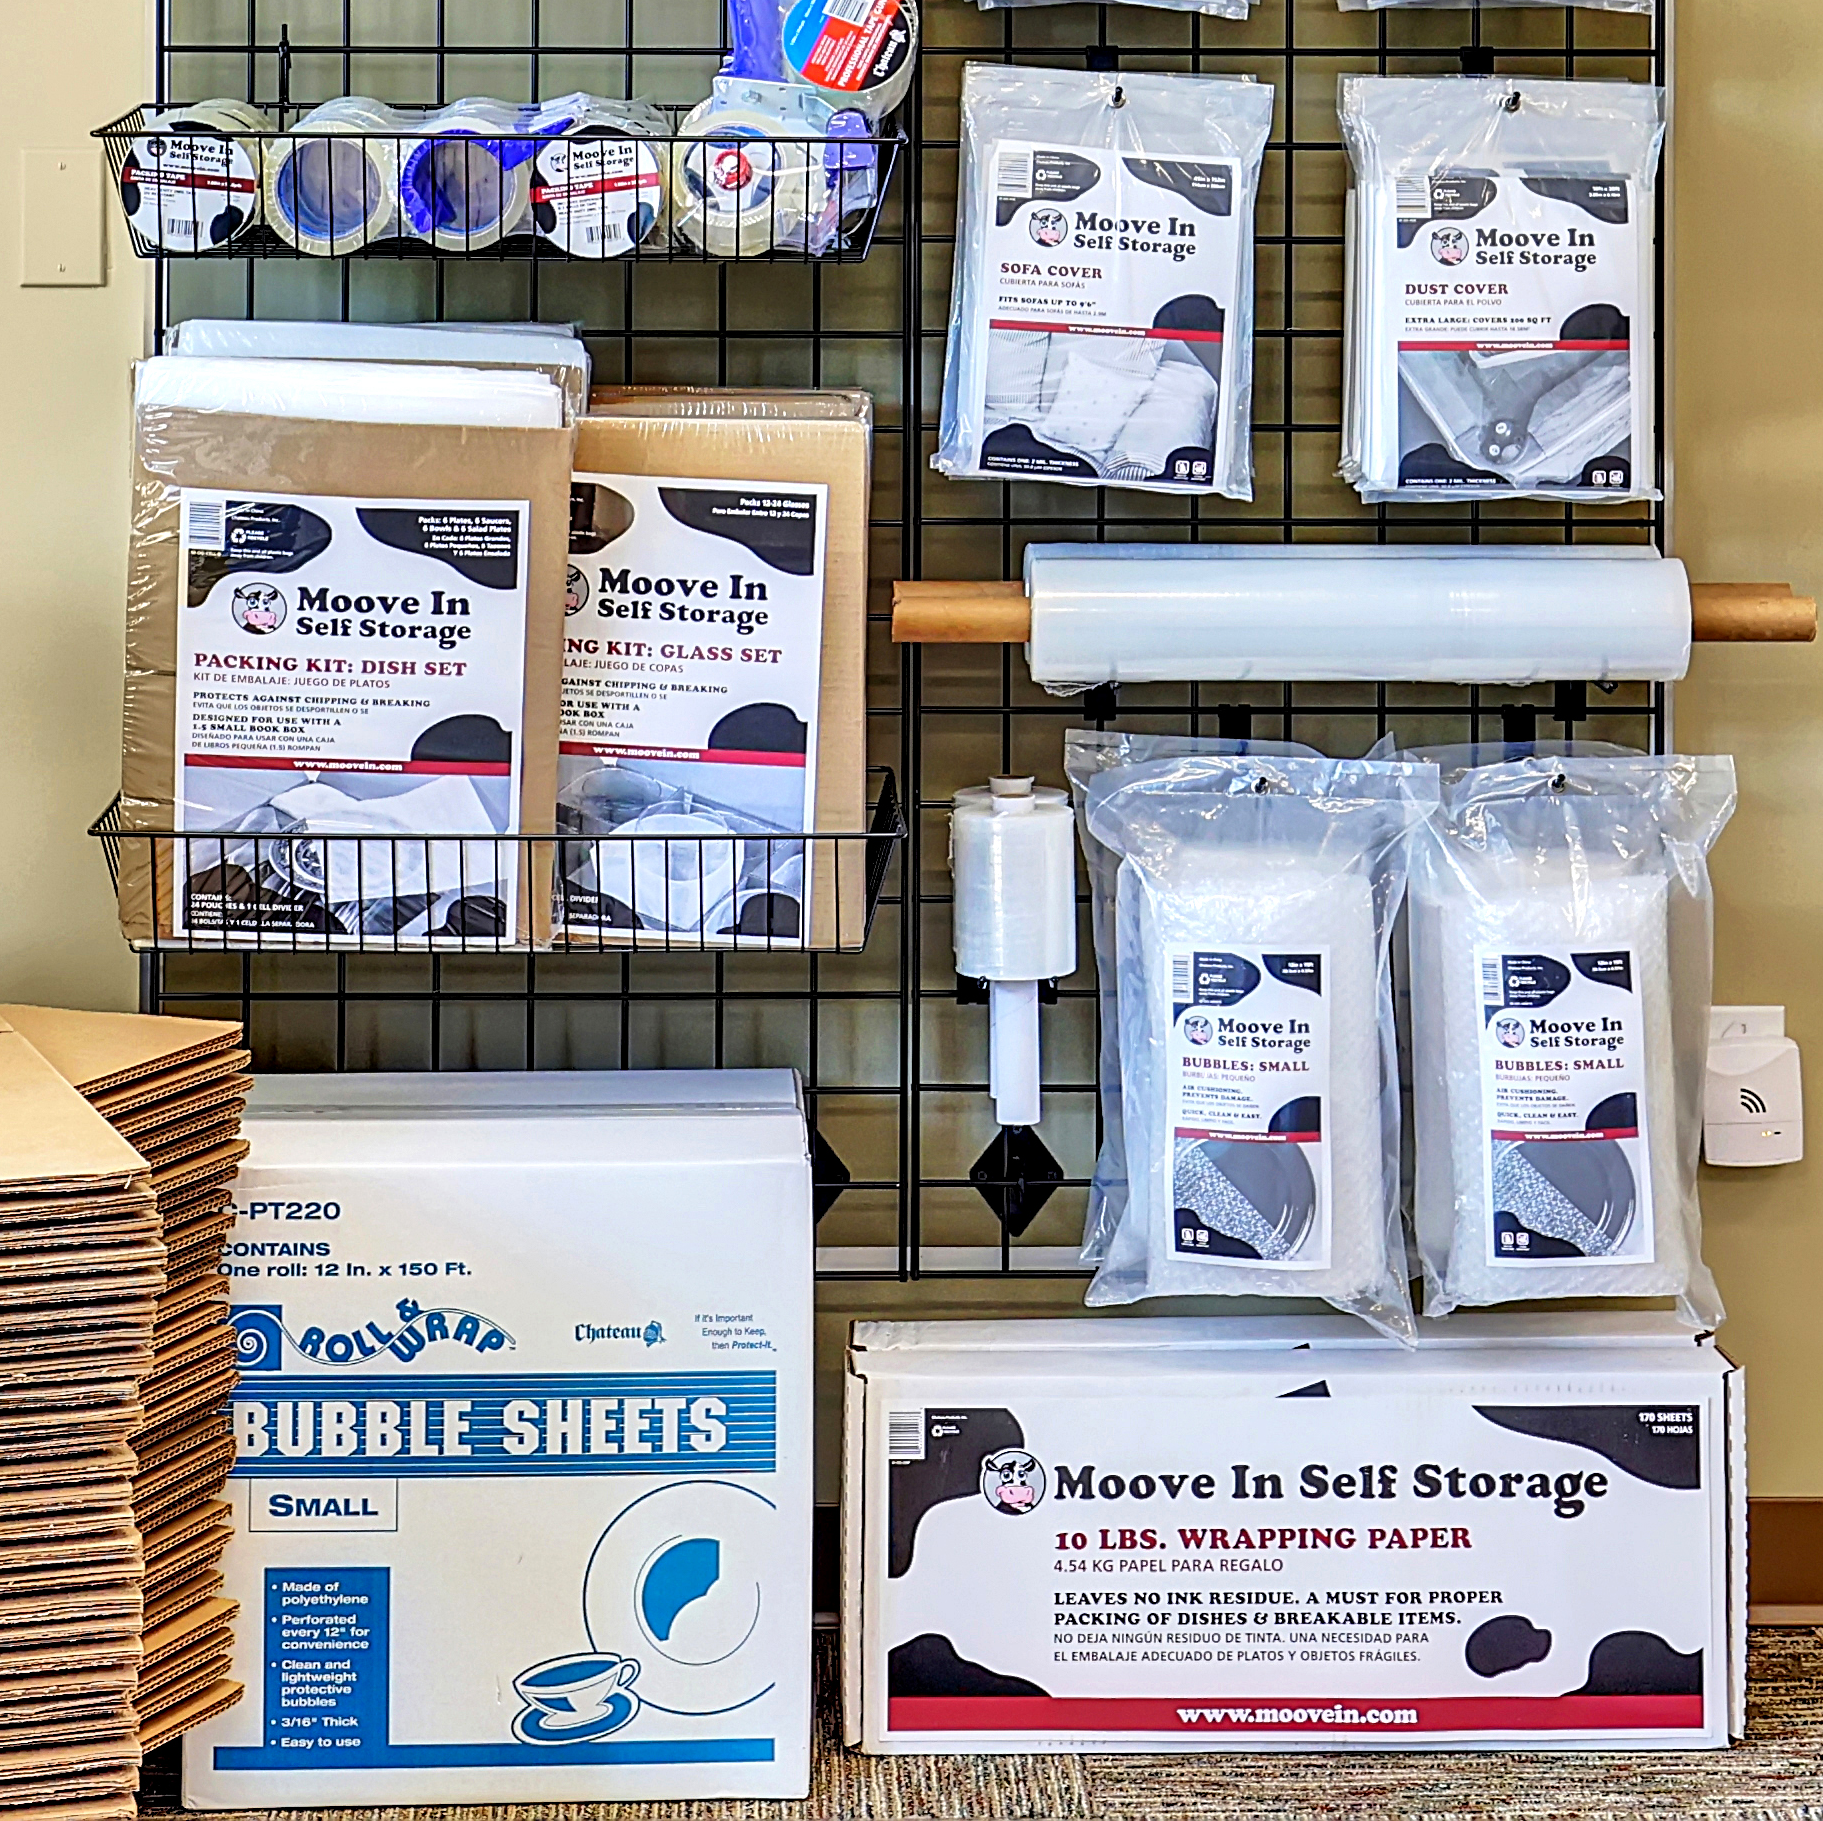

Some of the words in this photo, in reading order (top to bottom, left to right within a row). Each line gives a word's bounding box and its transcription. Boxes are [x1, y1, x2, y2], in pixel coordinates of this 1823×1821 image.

[837, 36, 869, 86] PROFESSIONAL
[864, 14, 878, 35] TAPE
[1001, 263, 1041, 275] SOFA
[1048, 266, 1102, 279] COVER
[1406, 284, 1448, 294] DUST
[1454, 284, 1508, 294] COVER
[297, 587, 419, 614] Moove
[431, 591, 470, 615] In
[296, 617, 352, 636] Self
[359, 619, 471, 650] Storage
[607, 641, 652, 657] KIT:
[661, 644, 732, 661] GLASS
[741, 648, 782, 663] SET
[195, 653, 298, 671] PACKING
[306, 659, 352, 673] KIT:
[361, 660, 416, 675] DISH
[424, 662, 467, 676] SET
[293, 760, 403, 771] www.moovein.com
[1496, 1060, 1568, 1071] BUBBLES:
[1574, 1058, 1624, 1070] SMALL
[218, 1243, 330, 1256] CONTAINS
[217, 1263, 259, 1276] One
[268, 1263, 306, 1276] roll:
[315, 1264, 339, 1276] 12
[347, 1263, 371, 1276] In.
[379, 1266, 391, 1276] x
[399, 1263, 438, 1276] 150
[446, 1263, 471, 1275] Ft.
[396, 1298, 422, 1322] &
[299, 1321, 394, 1362] ROLL
[388, 1312, 505, 1362] WRAP
[575, 1323, 641, 1344] Chateau
[235, 1400, 471, 1457] BUBBLE
[503, 1398, 727, 1455] SHEETS
[1638, 1412, 1655, 1422] 170
[1657, 1412, 1693, 1422] SHEETS
[1054, 1466, 1215, 1499] Moove
[1231, 1465, 1284, 1498] In
[1300, 1464, 1397, 1498] Self
[1413, 1464, 1608, 1518] Storage
[1055, 1533, 1087, 1550] 10
[1099, 1529, 1166, 1550] LBS.
[1178, 1528, 1356, 1549] WRAPPING
[1368, 1528, 1472, 1549] PAPER
[1054, 1560, 1087, 1572] 4.54
[1093, 1560, 1113, 1572] KG
[1120, 1560, 1166, 1572] PAPEL
[1172, 1559, 1214, 1572] PARA
[1220, 1559, 1283, 1571] REGALO
[282, 1582, 321, 1592] Made
[325, 1582, 339, 1592] of
[282, 1594, 368, 1606] polyethylene
[1177, 1705, 1417, 1723] www.moovein.com
